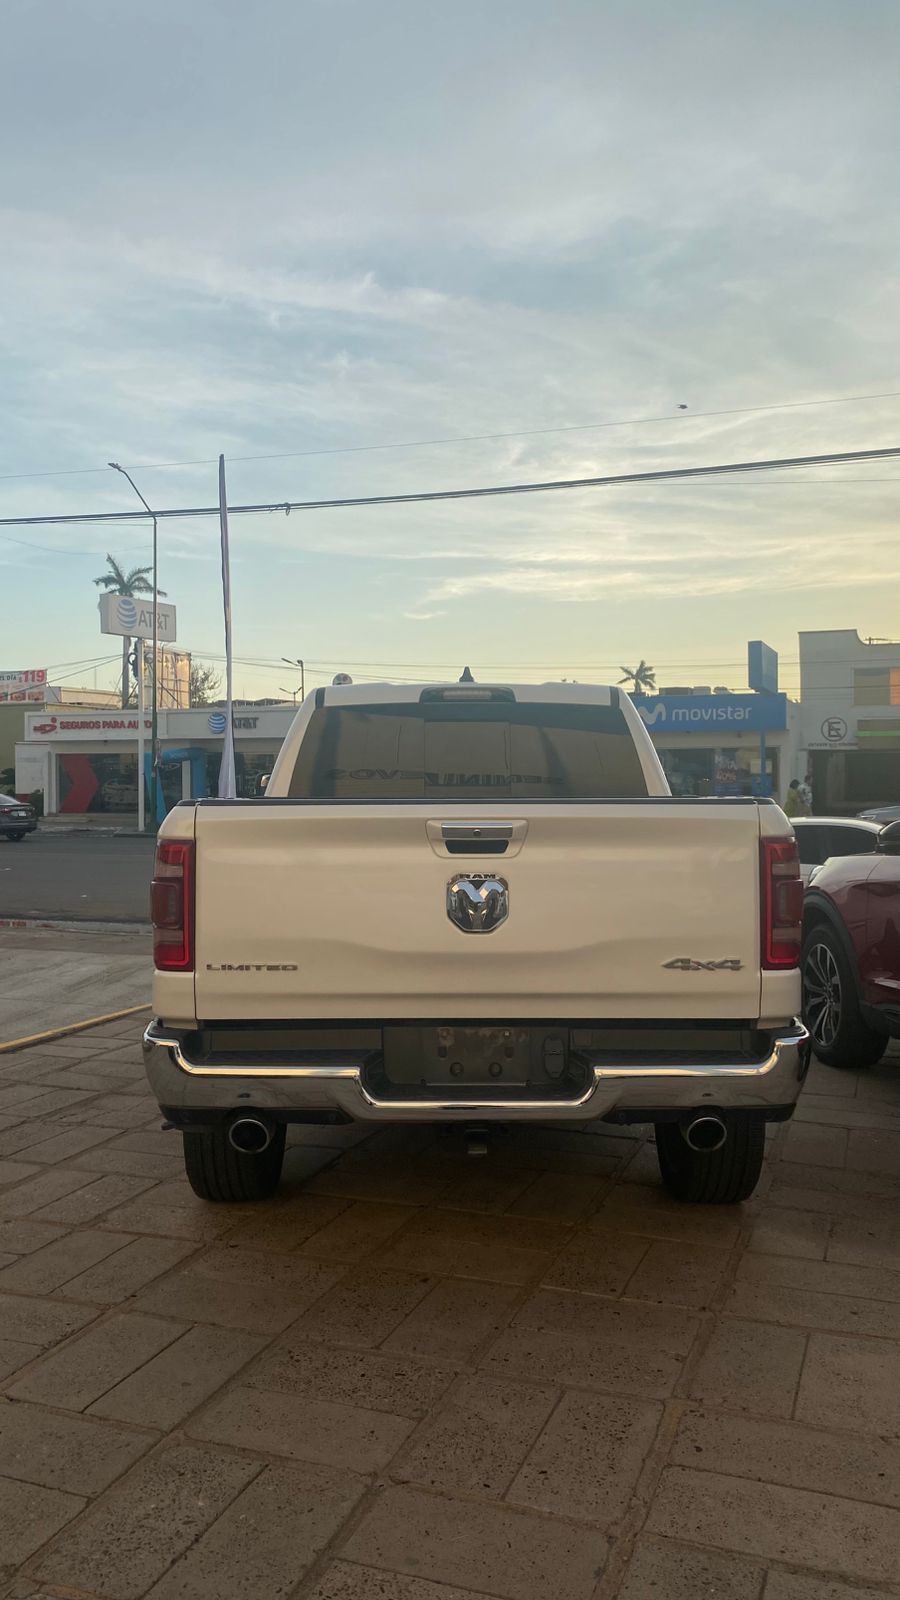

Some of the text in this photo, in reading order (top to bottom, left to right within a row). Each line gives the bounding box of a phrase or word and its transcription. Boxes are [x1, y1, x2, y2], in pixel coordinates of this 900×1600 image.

[138, 609, 169, 631] AT&T
[672, 705, 752, 721] movistar
[60, 720, 101, 729] SEGUROS
[102, 720, 125, 729] PARA
[206, 962, 299, 971] LIMITED
